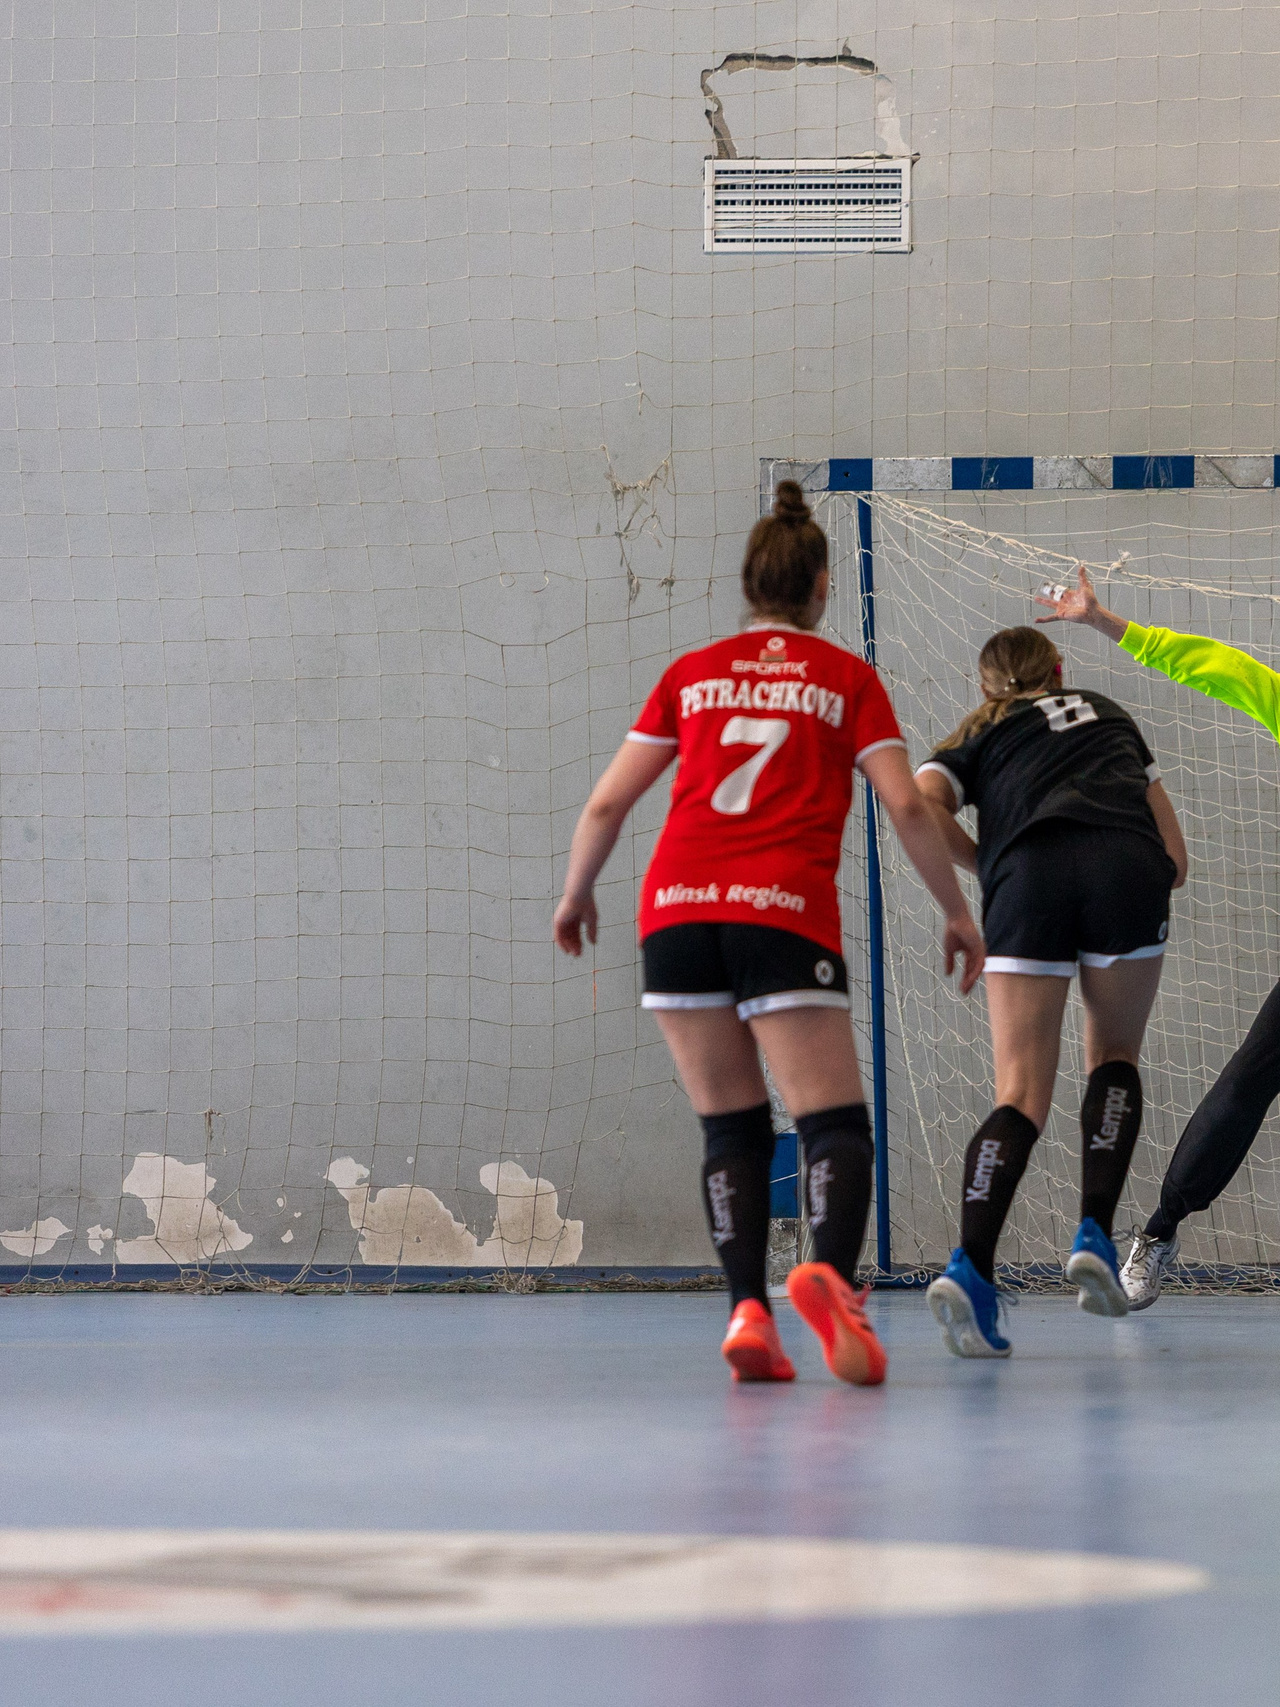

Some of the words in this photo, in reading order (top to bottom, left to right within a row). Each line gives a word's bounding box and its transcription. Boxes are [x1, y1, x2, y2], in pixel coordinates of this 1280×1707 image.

[731, 659, 809, 679] SPORTIX
[679, 678, 844, 728] PETRACHKOVA
[711, 715, 791, 815] 7
[653, 883, 721, 910] Minsk
[725, 884, 806, 913] Region
[1090, 1086, 1132, 1151] Kempa
[966, 1139, 1005, 1202] Kempa
